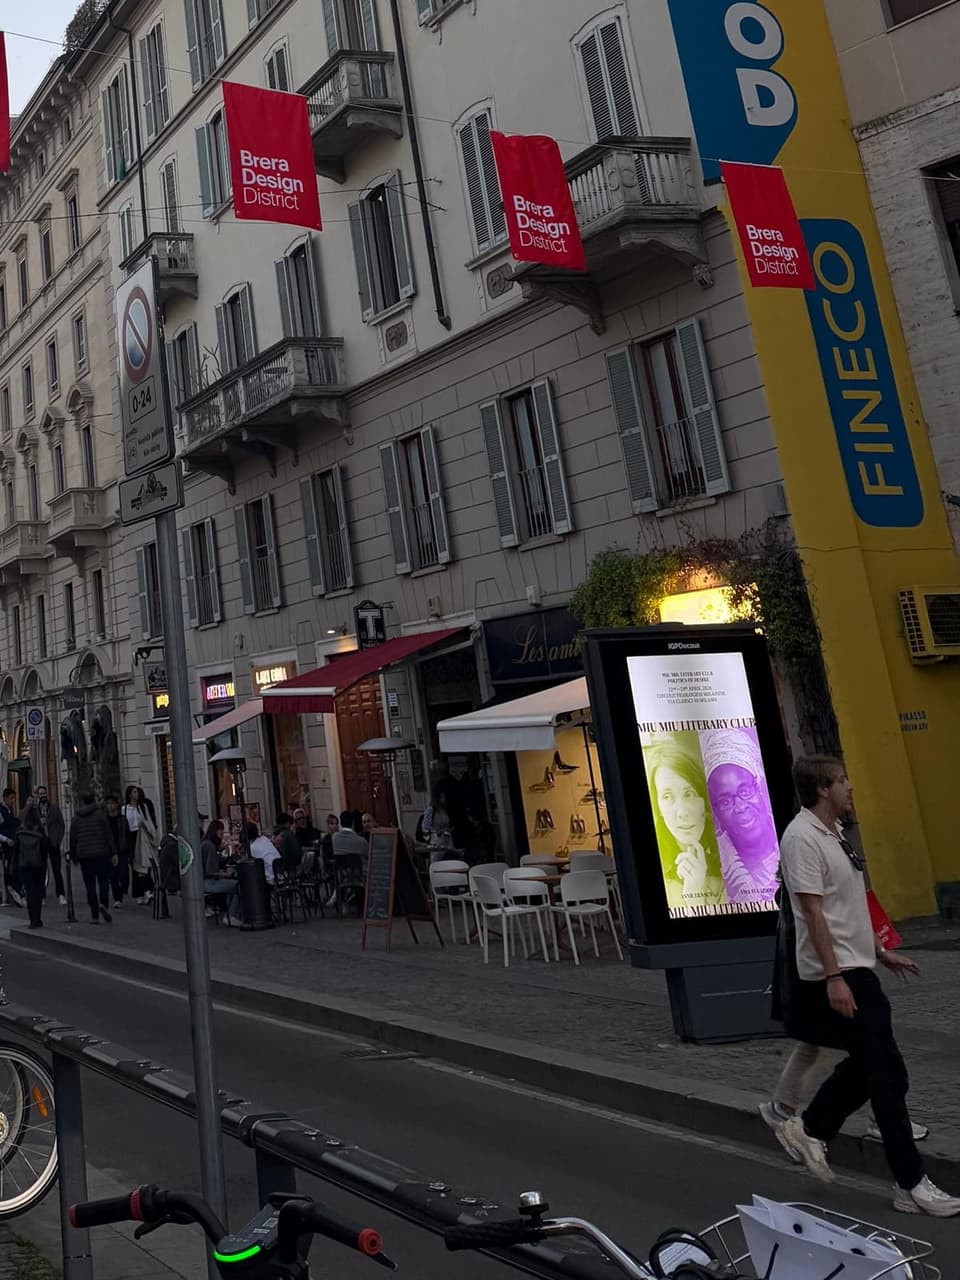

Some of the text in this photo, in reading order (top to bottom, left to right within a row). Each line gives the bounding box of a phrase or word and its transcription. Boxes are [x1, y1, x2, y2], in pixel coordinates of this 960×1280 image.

[240, 149, 289, 172] Brera
[242, 168, 304, 194] Design
[244, 187, 299, 210] District
[513, 195, 555, 217] Brera
[516, 212, 570, 239] Design
[746, 224, 784, 242] Brera
[519, 230, 568, 253] District
[750, 241, 799, 261] Design
[755, 258, 799, 275] District
[813, 241, 904, 496] FINECO
[132, 386, 152, 413] 0-24
[358, 609, 381, 639] T
[659, 721, 679, 732] MIU
[681, 719, 728, 732] LITERARY
[713, 901, 762, 915] LITERARY
